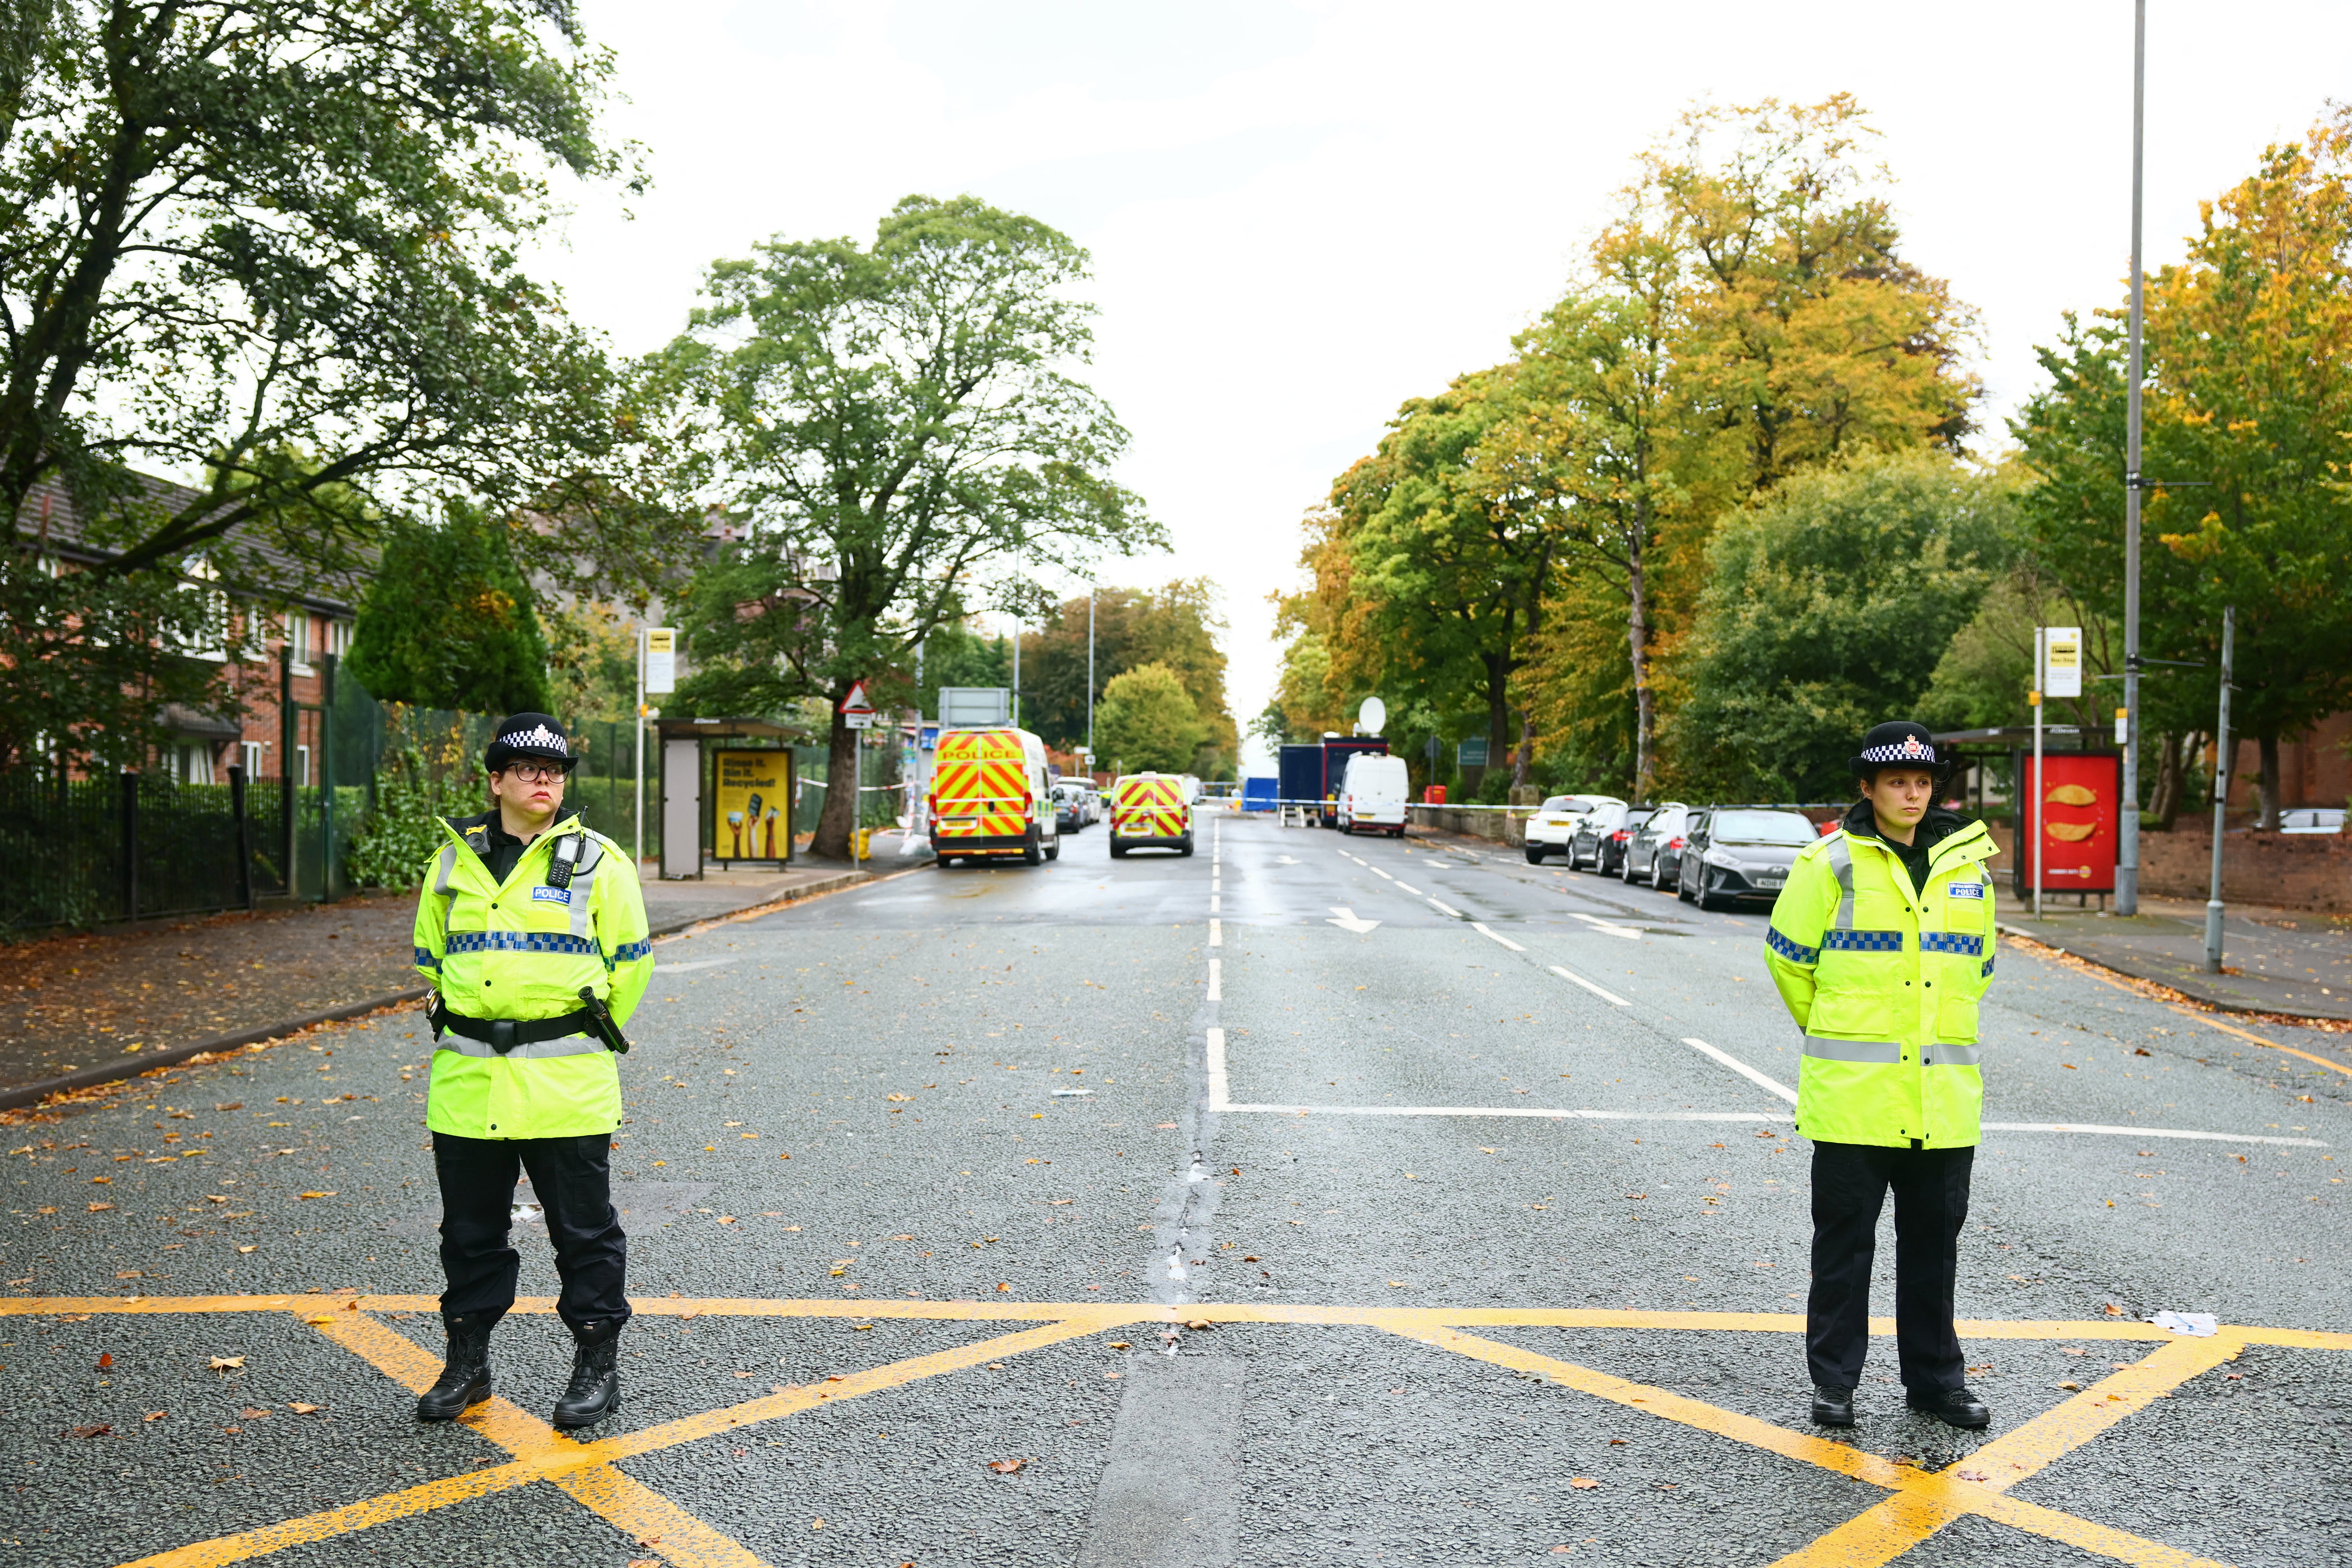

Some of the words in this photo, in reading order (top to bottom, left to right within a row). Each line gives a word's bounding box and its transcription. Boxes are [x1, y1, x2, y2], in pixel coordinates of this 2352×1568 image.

[943, 749, 1016, 760] POLICE
[535, 888, 569, 901] POLICE
[1955, 888, 1980, 897] POLICE
